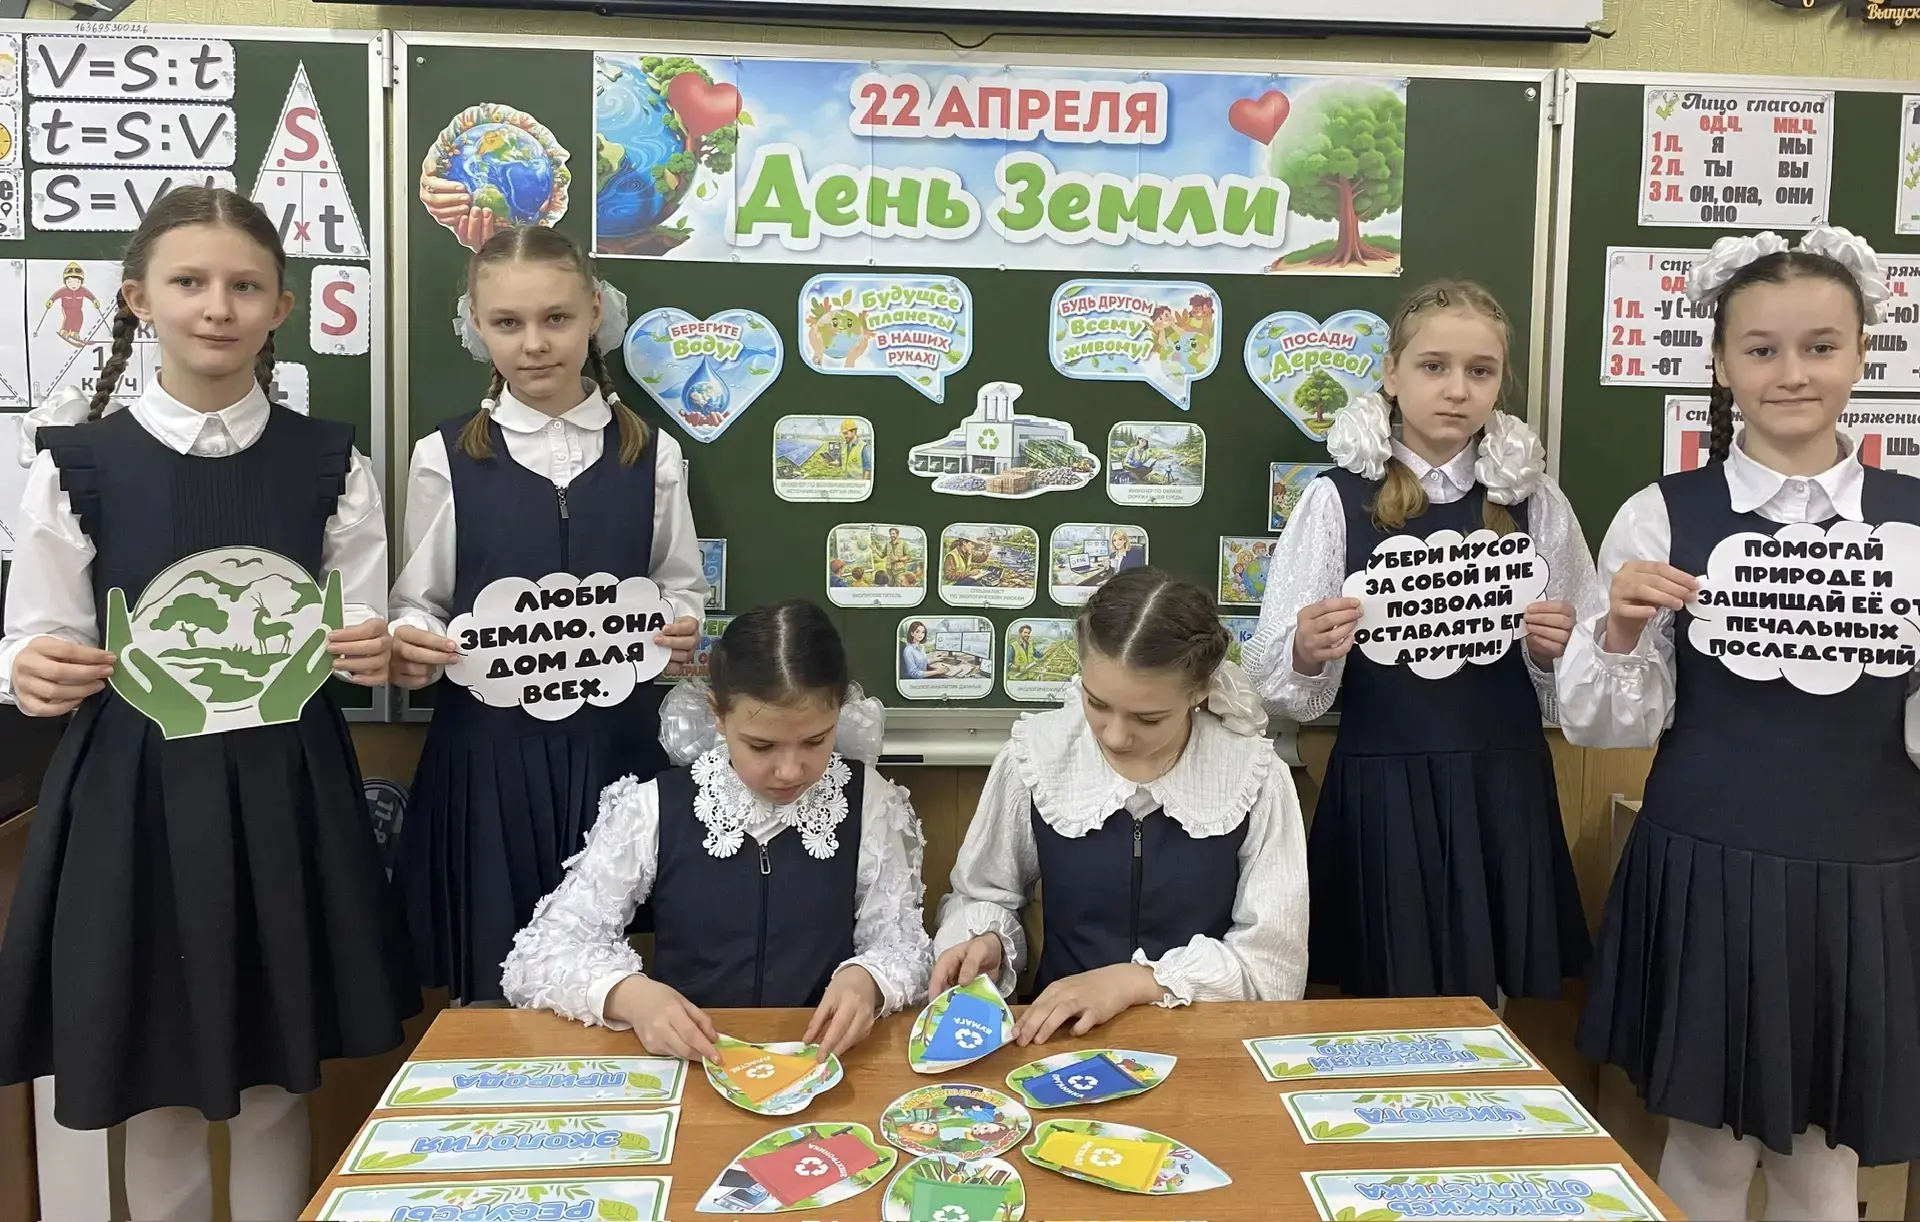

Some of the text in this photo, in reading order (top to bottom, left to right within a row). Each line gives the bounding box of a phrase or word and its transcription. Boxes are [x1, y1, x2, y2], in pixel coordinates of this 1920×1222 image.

[860, 83, 1157, 133] 22 АПРЕЛЯ
[1681, 93, 1825, 114] Лицо глагола
[284, 107, 319, 161] S
[1774, 117, 1817, 134] мн.ч.
[1652, 131, 1662, 152] 1
[1650, 155, 1663, 176] 2
[735, 154, 1280, 238] День Земли
[1650, 181, 1662, 202] 3
[320, 281, 358, 336] S
[862, 286, 961, 311] Будущее
[1061, 295, 1153, 315] БУДЬ ДРУГОМ
[1613, 297, 1623, 318] 1
[671, 322, 740, 337] БЕРЕГИТЕ
[867, 311, 954, 330] планеты
[1070, 317, 1146, 338] Всему
[877, 333, 951, 350] В НАШИХ
[1282, 332, 1354, 350] ПОСАДИ
[1612, 325, 1624, 346] 2
[673, 337, 744, 360] Воду!
[888, 350, 938, 366] РУКАХ!
[1063, 341, 1153, 361] живому!
[1272, 350, 1371, 379] Дерево!
[1610, 354, 1623, 376] 3
[1368, 537, 1530, 570] УБЕРИ МУСОР
[1744, 538, 1884, 560] ПОМОГАЙ
[1365, 562, 1533, 595] ЗА СОБОЙ И НЕ
[1735, 566, 1893, 587] ПРИРОДЕ И
[514, 584, 617, 613] ЛЮБИ
[1387, 585, 1513, 618] ПОЗВОЛЯЙ
[1698, 590, 1845, 613] ЗАЩИЩАЙ
[1852, 592, 1883, 613] ЕЁ
[460, 612, 667, 651] ЗЕМЛЮ, ОНА
[1354, 612, 1525, 644] ОСТАВЛЯТЬ ЕГ
[1726, 616, 1899, 640] ПЕЧАЛЬНЫХ
[486, 650, 567, 679] ДОМ
[574, 642, 644, 668] ДЛЯ
[1395, 639, 1502, 663] ДРУГИМ!
[1709, 639, 1916, 666] ПОСЛЕДСТВИЙ
[523, 677, 609, 704] ВСЕХ.
[953, 1017, 993, 1035] БУМАГА
[1317, 1038, 1451, 1057] РАЗУМНО
[1308, 1049, 1479, 1072] ПОТРЕБЛЯЙ
[453, 1072, 626, 1090] ПРИРОДА
[1355, 1105, 1525, 1125] ЧИСТОТА
[411, 1131, 621, 1154] ЭКОЛОГИЯ
[1355, 1180, 1593, 1202] ОТ ПЛАСТИКА
[392, 1200, 595, 1222] РЕСУРСЫ
[1387, 1199, 1585, 1218] ОТКАЖИСЬ
